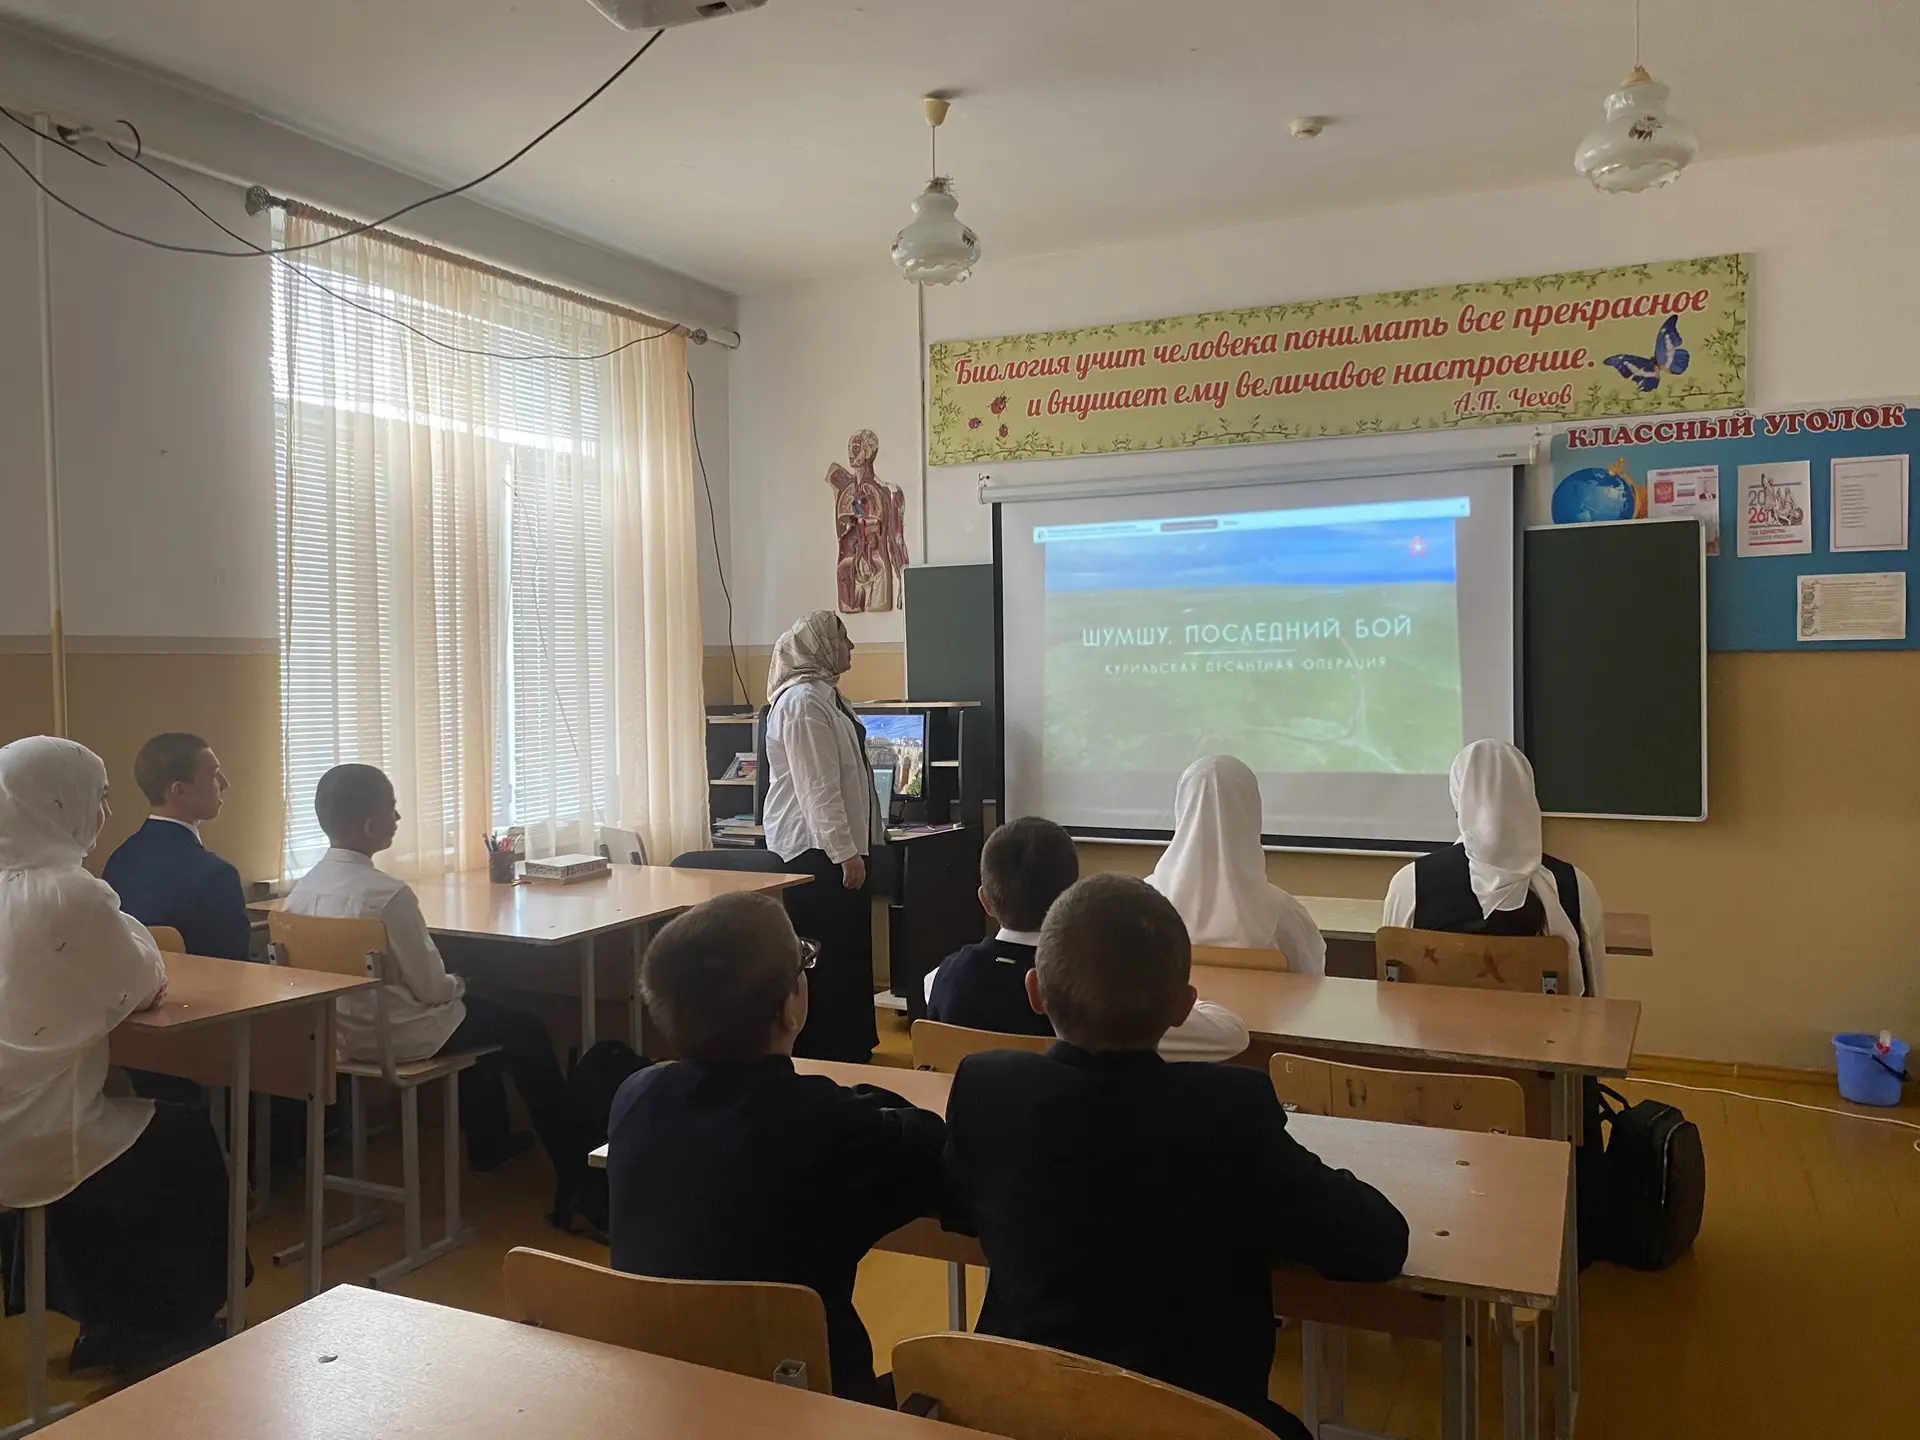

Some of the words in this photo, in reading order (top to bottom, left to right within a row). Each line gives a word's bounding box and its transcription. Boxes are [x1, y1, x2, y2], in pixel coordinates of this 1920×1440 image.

[954, 356, 1070, 385] Биология
[1076, 347, 1146, 380] учит
[1153, 331, 1278, 364] человека
[1284, 316, 1448, 351] понимать
[1457, 304, 1506, 335] все
[1512, 288, 1710, 336] прекрасное
[1026, 398, 1042, 417] и
[1047, 388, 1167, 420] внушает
[1173, 380, 1229, 409] ему
[1236, 360, 1387, 398] величавое
[1392, 347, 1596, 388] настроение.
[1508, 384, 1572, 408] Чехов
[1567, 414, 1755, 449] КЛАССНЫЙ
[1765, 404, 1906, 435] УГОЛОК
[1748, 489, 1766, 507] 20
[1748, 507, 1766, 524] 26
[1082, 626, 1173, 647] ШУМШУ.
[1184, 617, 1340, 644] ПОСЛЕДНИЙ
[1355, 614, 1413, 639] БОЙ
[1104, 661, 1198, 675] КУРИЛЬСКАЯ
[1205, 658, 1294, 673] ДЕСАНТНАЯ
[1302, 655, 1387, 670] ОПЕРАЦИЯ
